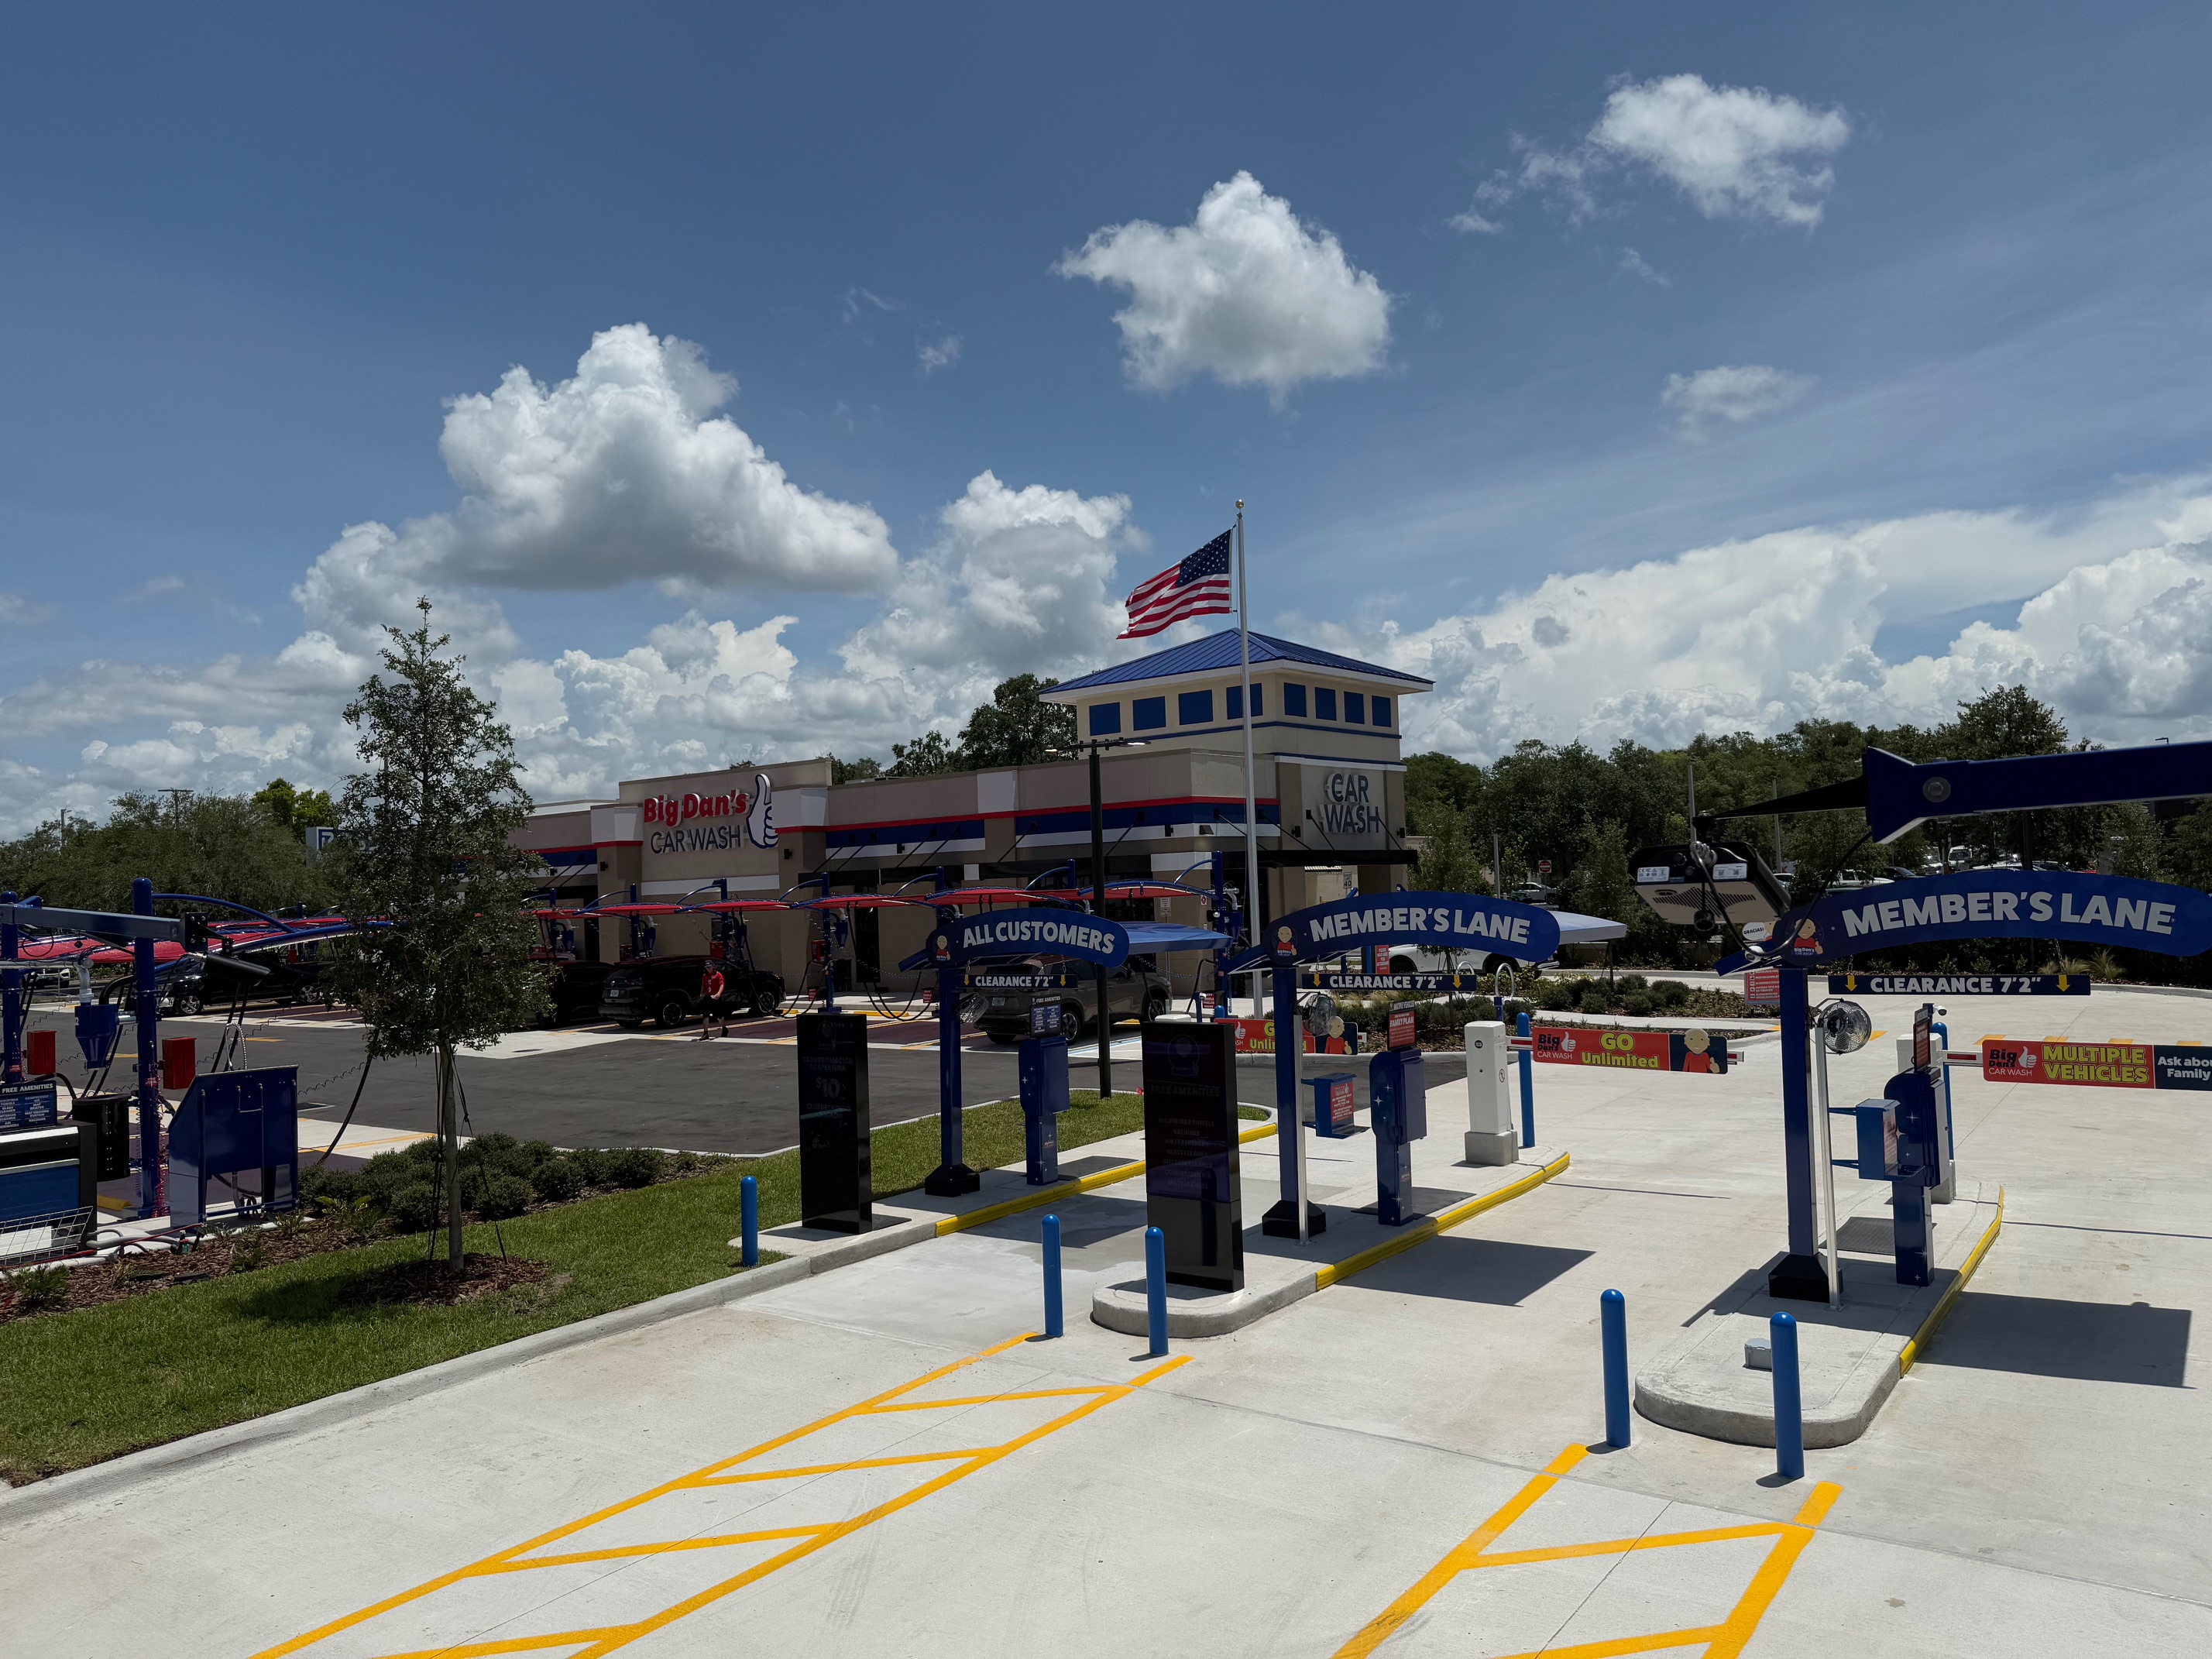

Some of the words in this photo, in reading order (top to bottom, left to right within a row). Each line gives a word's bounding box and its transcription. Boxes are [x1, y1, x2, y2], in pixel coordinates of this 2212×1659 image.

[1331, 773, 1369, 802] CAR
[644, 794, 681, 827] Big
[683, 789, 749, 819] Dan's
[1323, 804, 1379, 833] WASH
[651, 830, 685, 854] CAR
[689, 825, 741, 850] WASH
[1841, 891, 2054, 938] MEMBER'S
[2060, 892, 2176, 936] LANE
[1309, 907, 1450, 942] MEMBER'S
[1453, 909, 1530, 944] LANE
[963, 924, 994, 948] ALL
[995, 920, 1115, 954] CUSTOMERS
[975, 976, 1032, 987] CLEARANCE
[1034, 976, 1054, 988] 7'2"
[1329, 975, 1411, 988] CLEARANCE
[1415, 976, 1443, 989] 7'2"
[1870, 977, 1994, 993] CLEARANCE
[2000, 977, 2042, 994] 7'2"
[1403, 1016, 1414, 1025] PLAN
[1538, 1033, 1561, 1046] Big
[1599, 1032, 1635, 1052] GO
[1581, 1052, 1660, 1069] Unlimited
[1990, 1049, 2018, 1063] Big
[2042, 1045, 2147, 1065] MULTIPLE
[2157, 1056, 2183, 1066] Ask
[2042, 1063, 2150, 1084] VEHICLES
[2166, 1068, 2211, 1081] Family
[19, 1083, 53, 1092] AMENITIES
[815, 1076, 841, 1099] $10
[1172, 1087, 1220, 1097] AMENITIES
